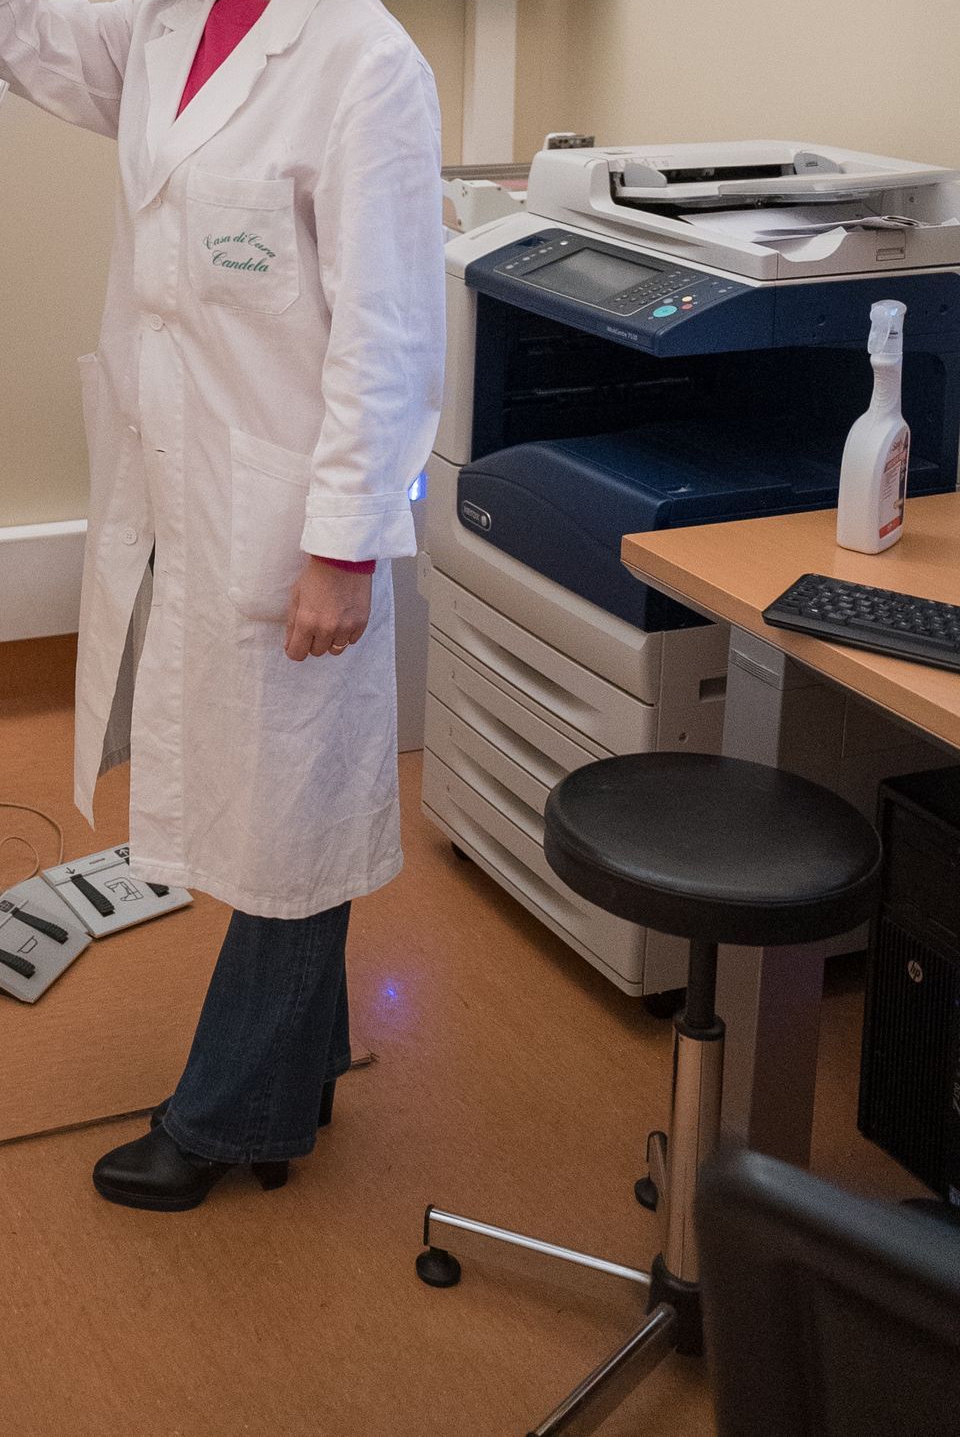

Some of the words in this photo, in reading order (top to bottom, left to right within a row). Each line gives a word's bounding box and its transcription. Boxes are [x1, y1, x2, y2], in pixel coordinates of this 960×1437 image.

[203, 233, 231, 250] Casa
[233, 232, 247, 243] di
[247, 233, 276, 258] Cura
[212, 250, 270, 272] Candela
